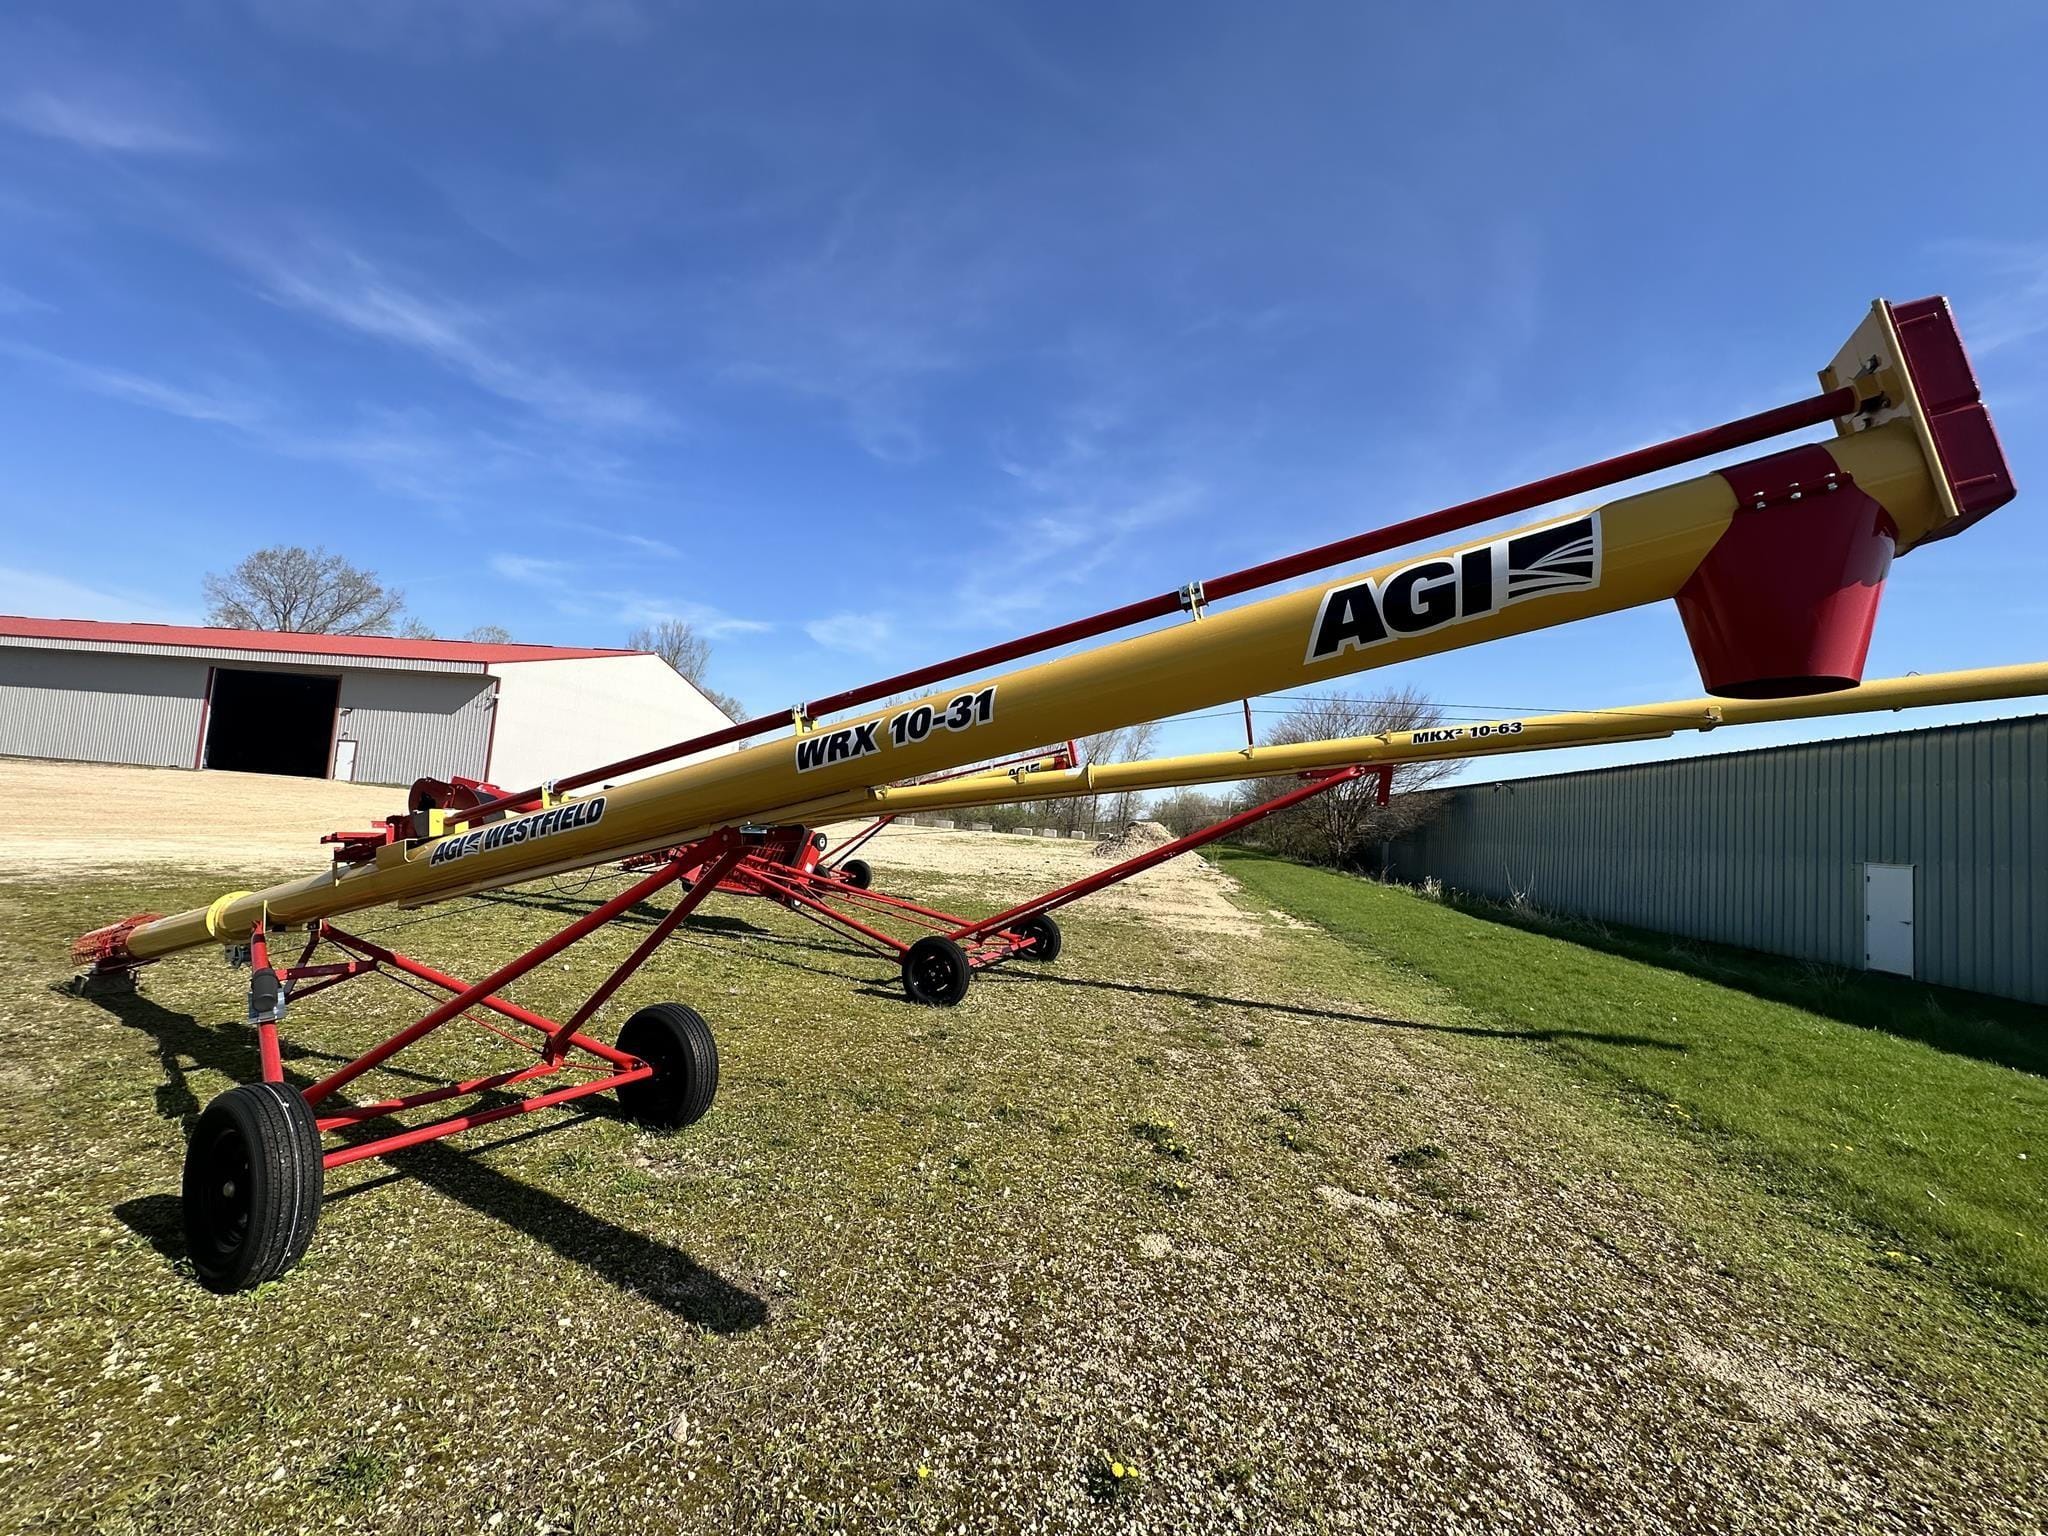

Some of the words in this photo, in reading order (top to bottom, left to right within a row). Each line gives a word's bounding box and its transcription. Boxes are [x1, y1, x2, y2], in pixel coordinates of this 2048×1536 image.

[1311, 545, 1494, 659] AGI
[797, 720, 882, 772] WRX
[889, 687, 998, 745] 10-31
[1470, 722, 1522, 738] 10-63
[430, 837, 465, 865] AGI
[483, 797, 607, 850] WESTFIELD
